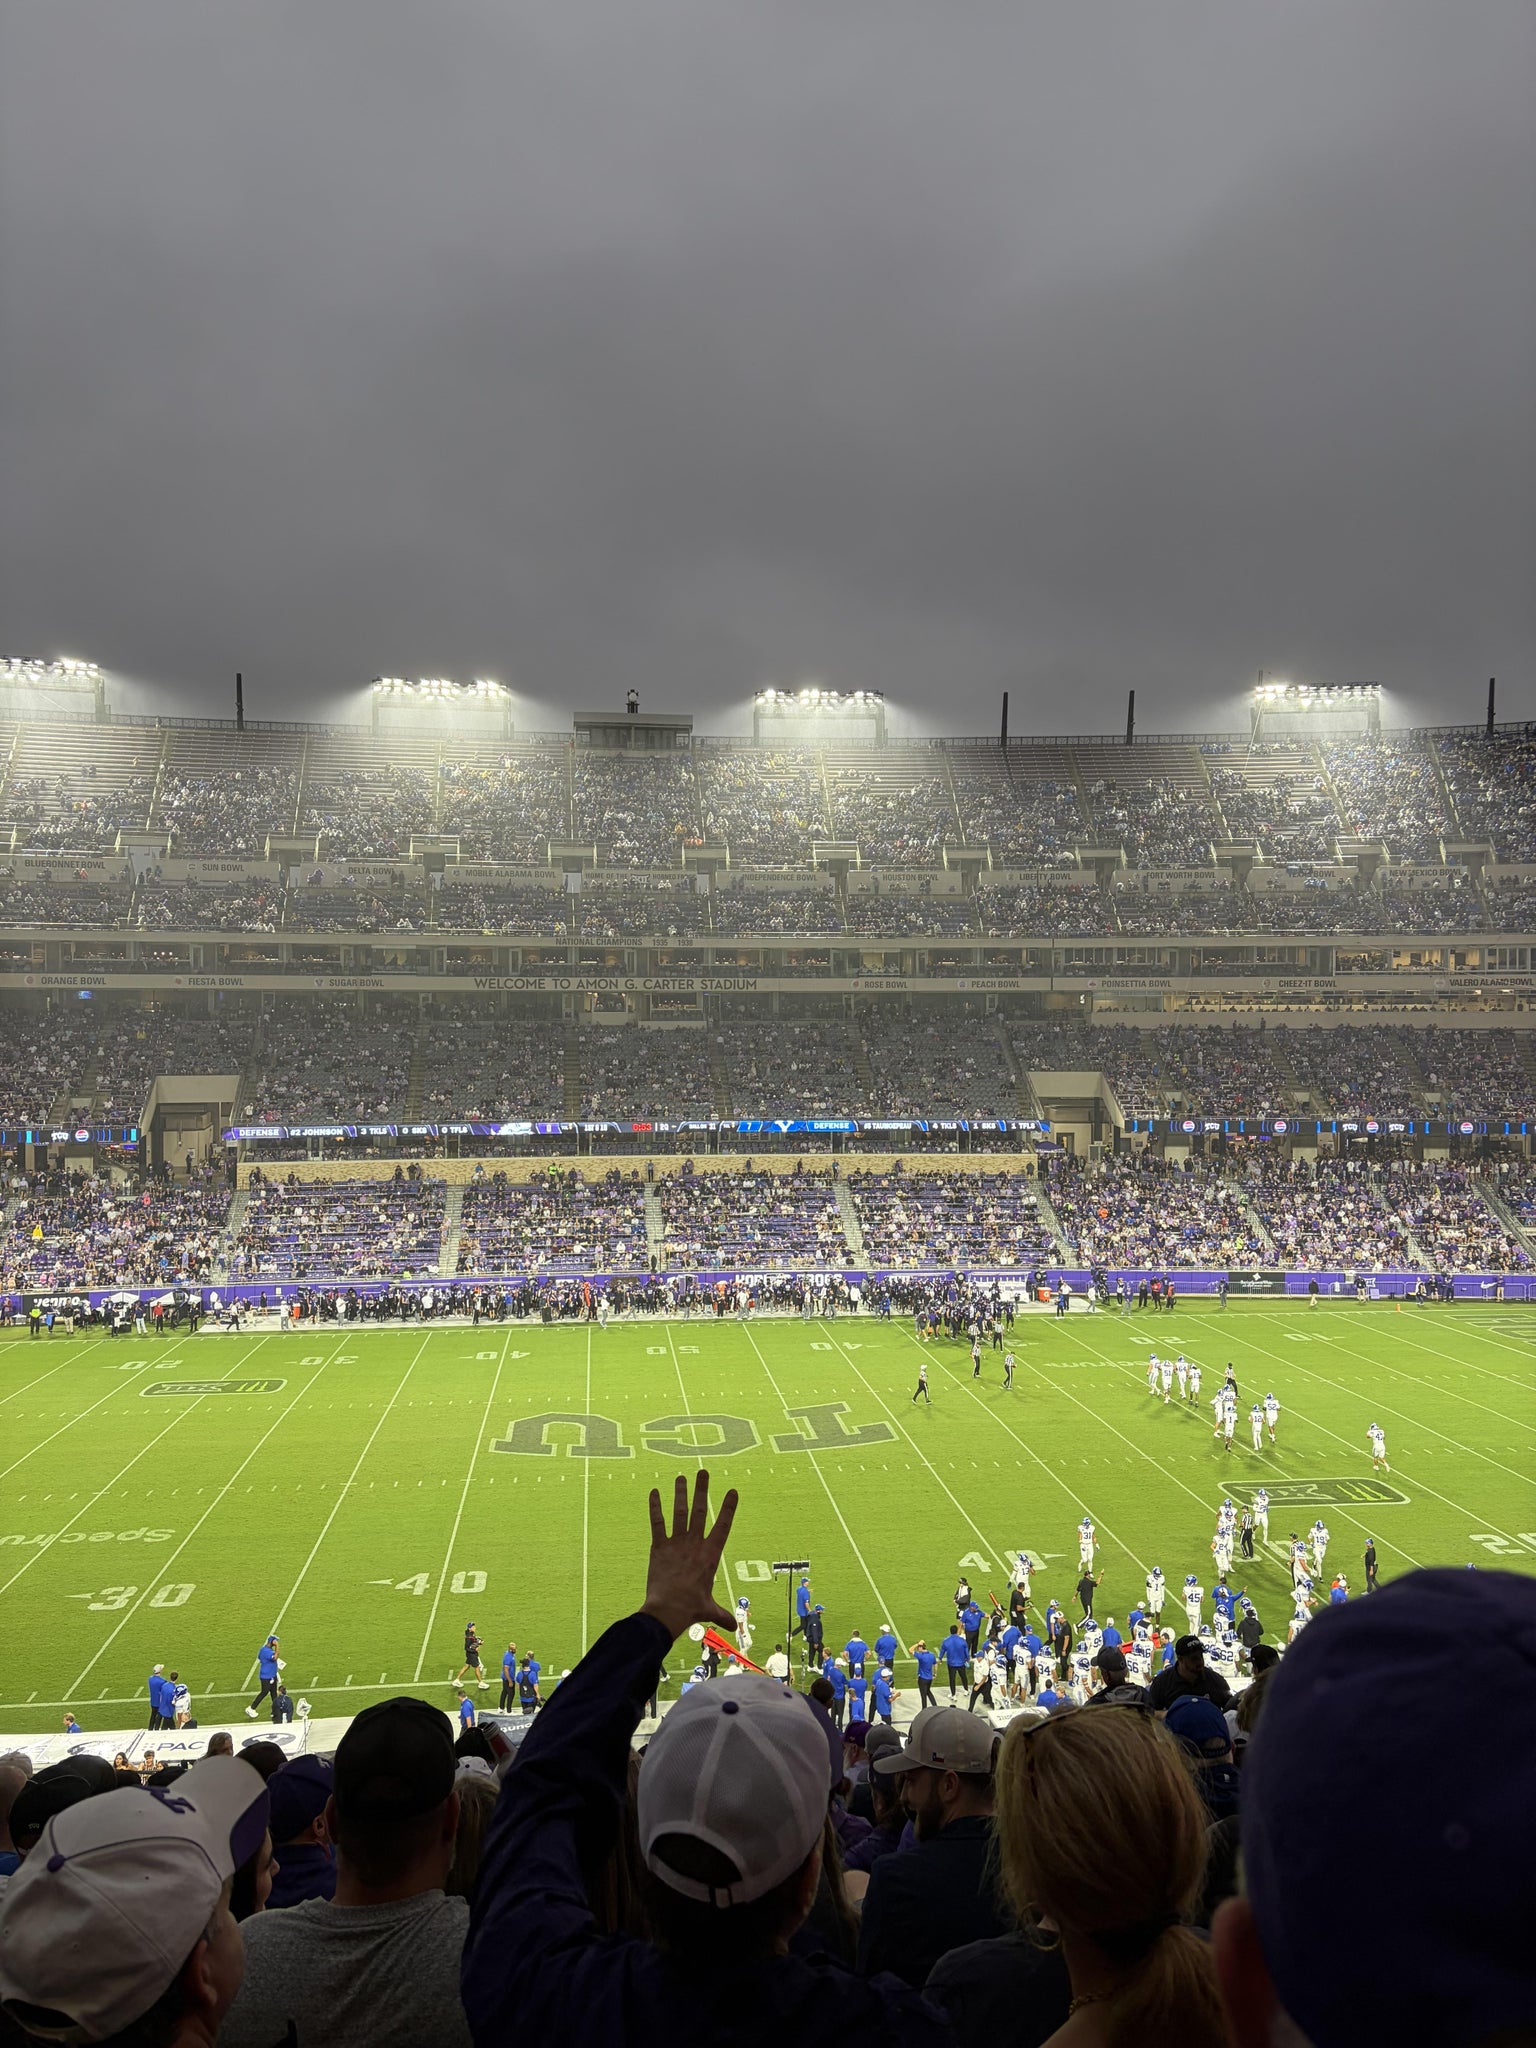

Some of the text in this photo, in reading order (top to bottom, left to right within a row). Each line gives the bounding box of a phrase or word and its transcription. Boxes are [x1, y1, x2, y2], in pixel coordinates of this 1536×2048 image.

[24, 860, 106, 870] BLUEBONNET BOWL
[202, 863, 244, 872] SUN BOWL
[465, 870, 556, 878] MOBILE ALABAMA BOWL
[41, 977, 107, 985] ORANGE BOWL
[474, 978, 757, 990] WELCOME TO AMON G. CARTER STADIUM
[1278, 980, 1337, 988] CHEEZ-IT BOWL
[1450, 979, 1477, 987] VALERO
[775, 1120, 794, 1132] Y
[489, 1401, 899, 1459] TCU
[394, 1571, 488, 1595] 40
[87, 1584, 197, 1611] 30
[1188, 1593, 1200, 1603] 45
[1220, 1650, 1233, 1662] 62
[1038, 1664, 1050, 1676] 34
[1127, 1661, 1139, 1673] 56
